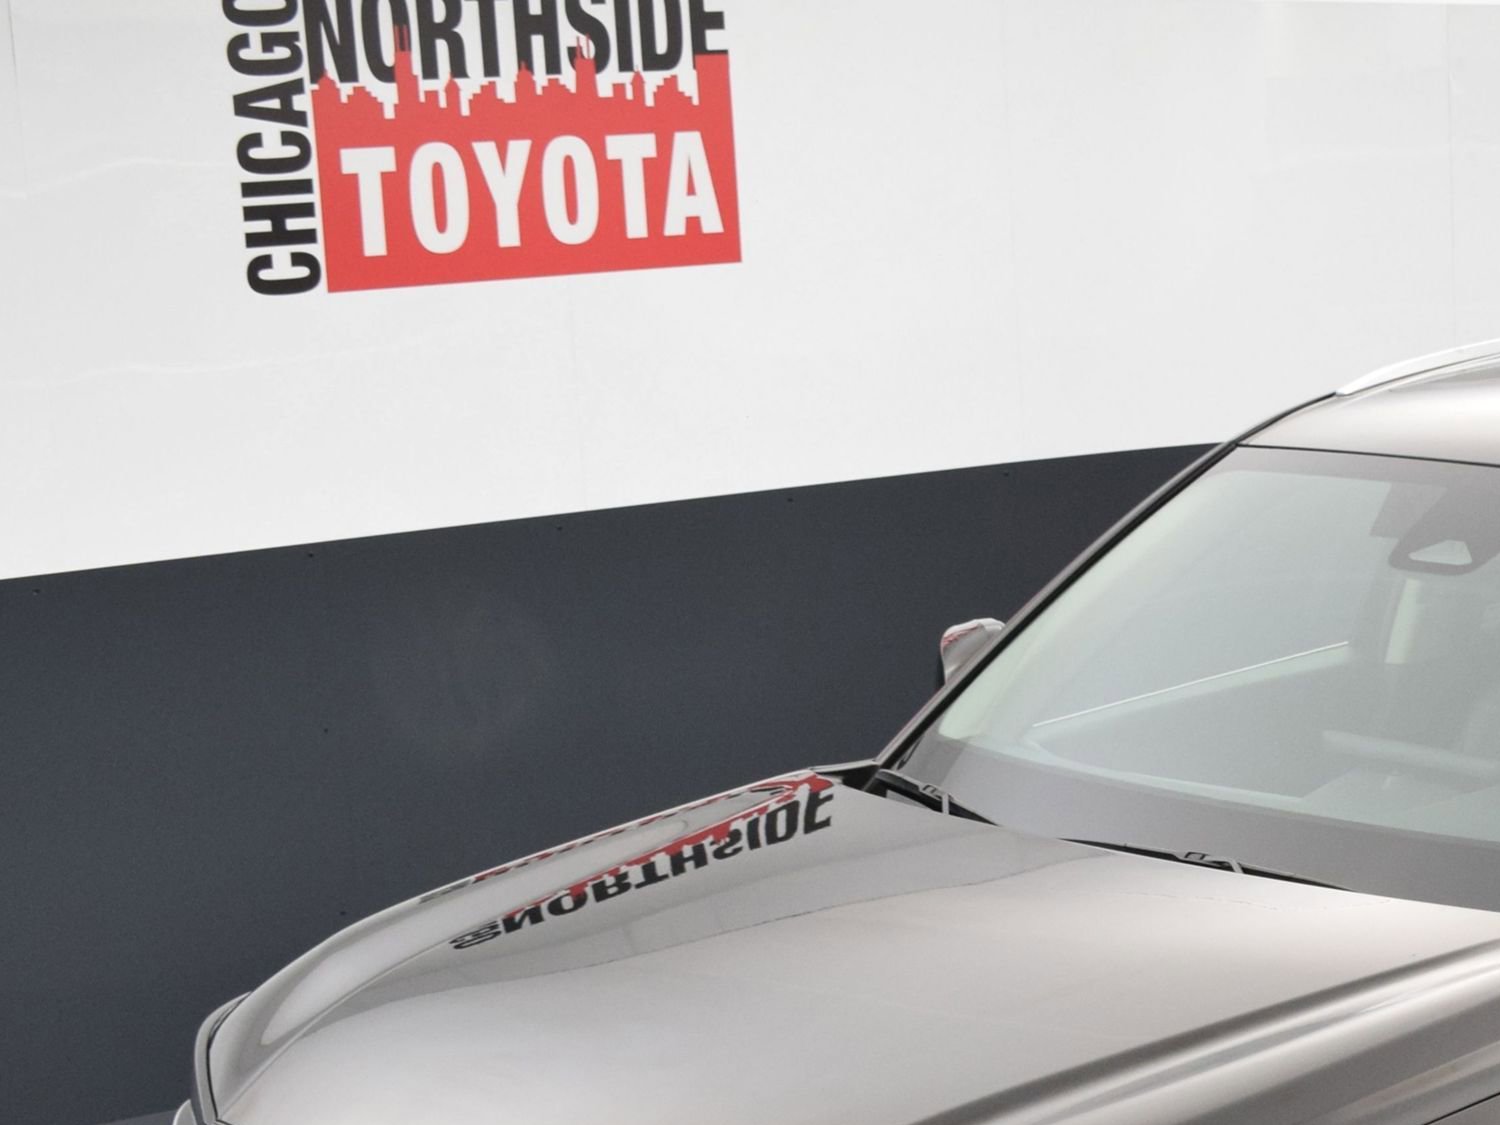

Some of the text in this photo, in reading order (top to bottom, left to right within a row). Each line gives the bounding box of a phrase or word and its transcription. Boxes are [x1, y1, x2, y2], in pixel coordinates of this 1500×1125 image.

[303, 0, 729, 84] NORTHSIDE
[222, 0, 322, 296] CHICAGO
[339, 130, 725, 258] TOYOTA
